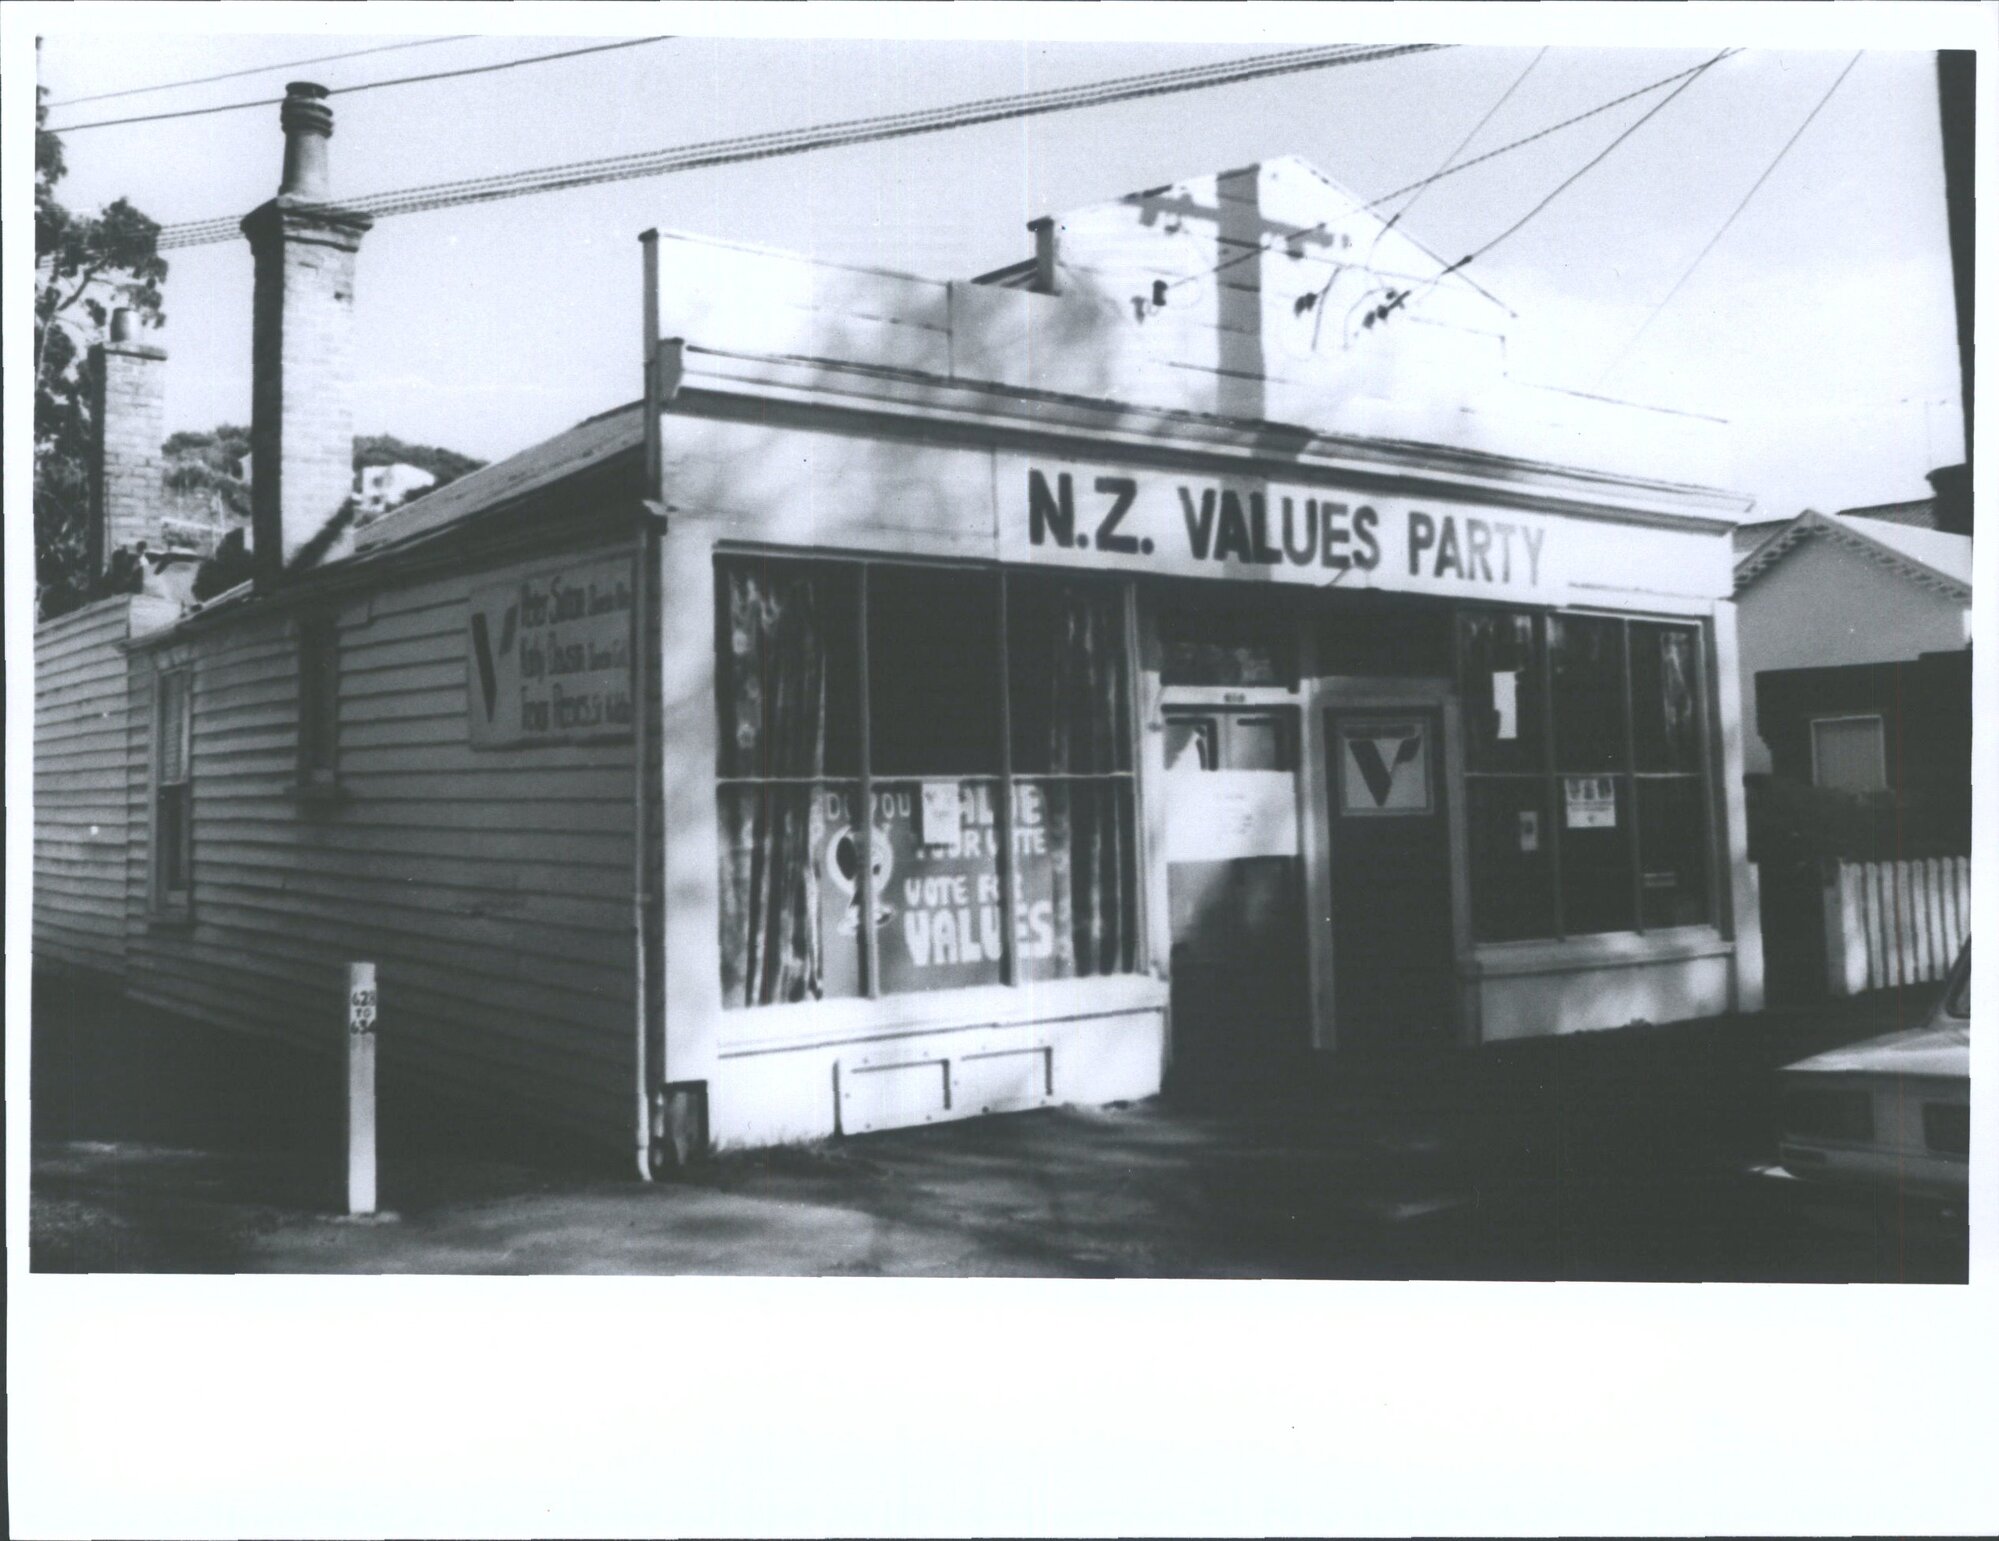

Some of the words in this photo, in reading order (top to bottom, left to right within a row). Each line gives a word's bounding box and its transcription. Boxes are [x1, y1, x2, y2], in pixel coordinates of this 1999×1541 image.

[1028, 468, 1155, 555] N.Z.
[1178, 486, 1382, 572] VALUES
[1408, 511, 1546, 587] PARTY
[826, 792, 851, 821] D
[903, 876, 968, 906] VOTE
[904, 900, 1054, 967] VALUES
[351, 991, 377, 1007] 628
[355, 1007, 372, 1018] TO
